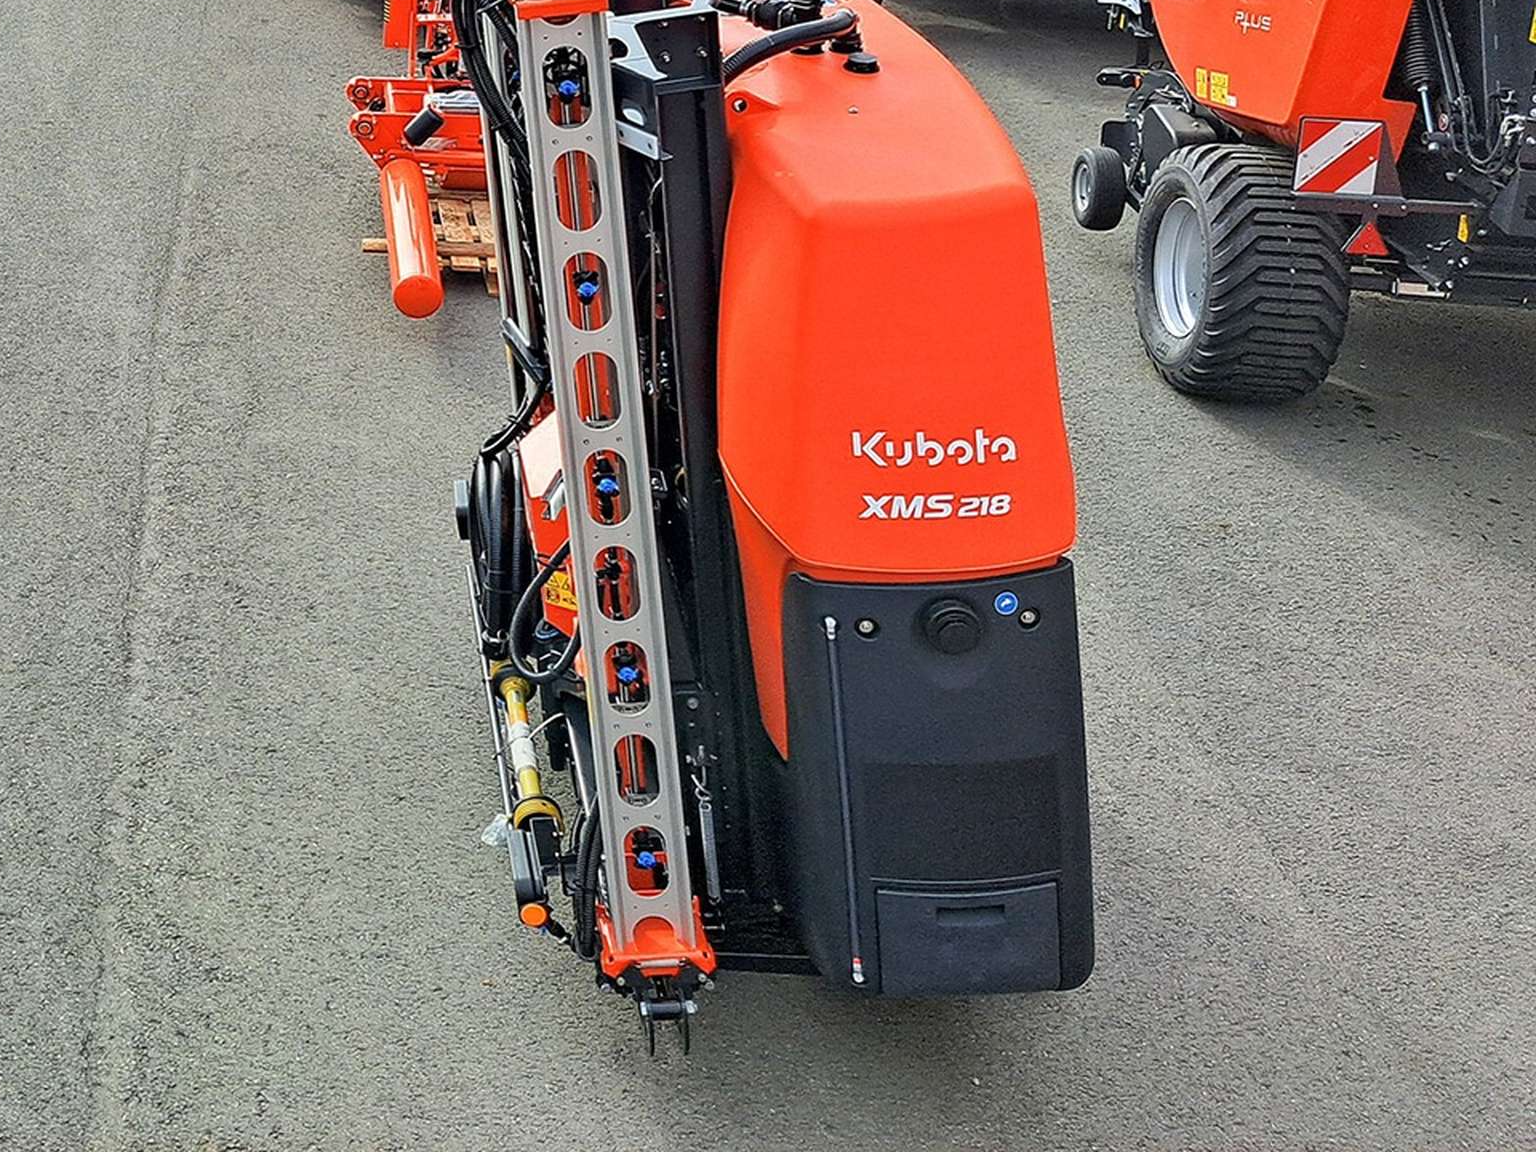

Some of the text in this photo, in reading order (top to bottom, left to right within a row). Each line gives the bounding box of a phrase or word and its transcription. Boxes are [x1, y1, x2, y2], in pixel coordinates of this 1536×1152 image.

[852, 429, 1017, 466] Kubota
[858, 494, 1012, 519] XMS 218
